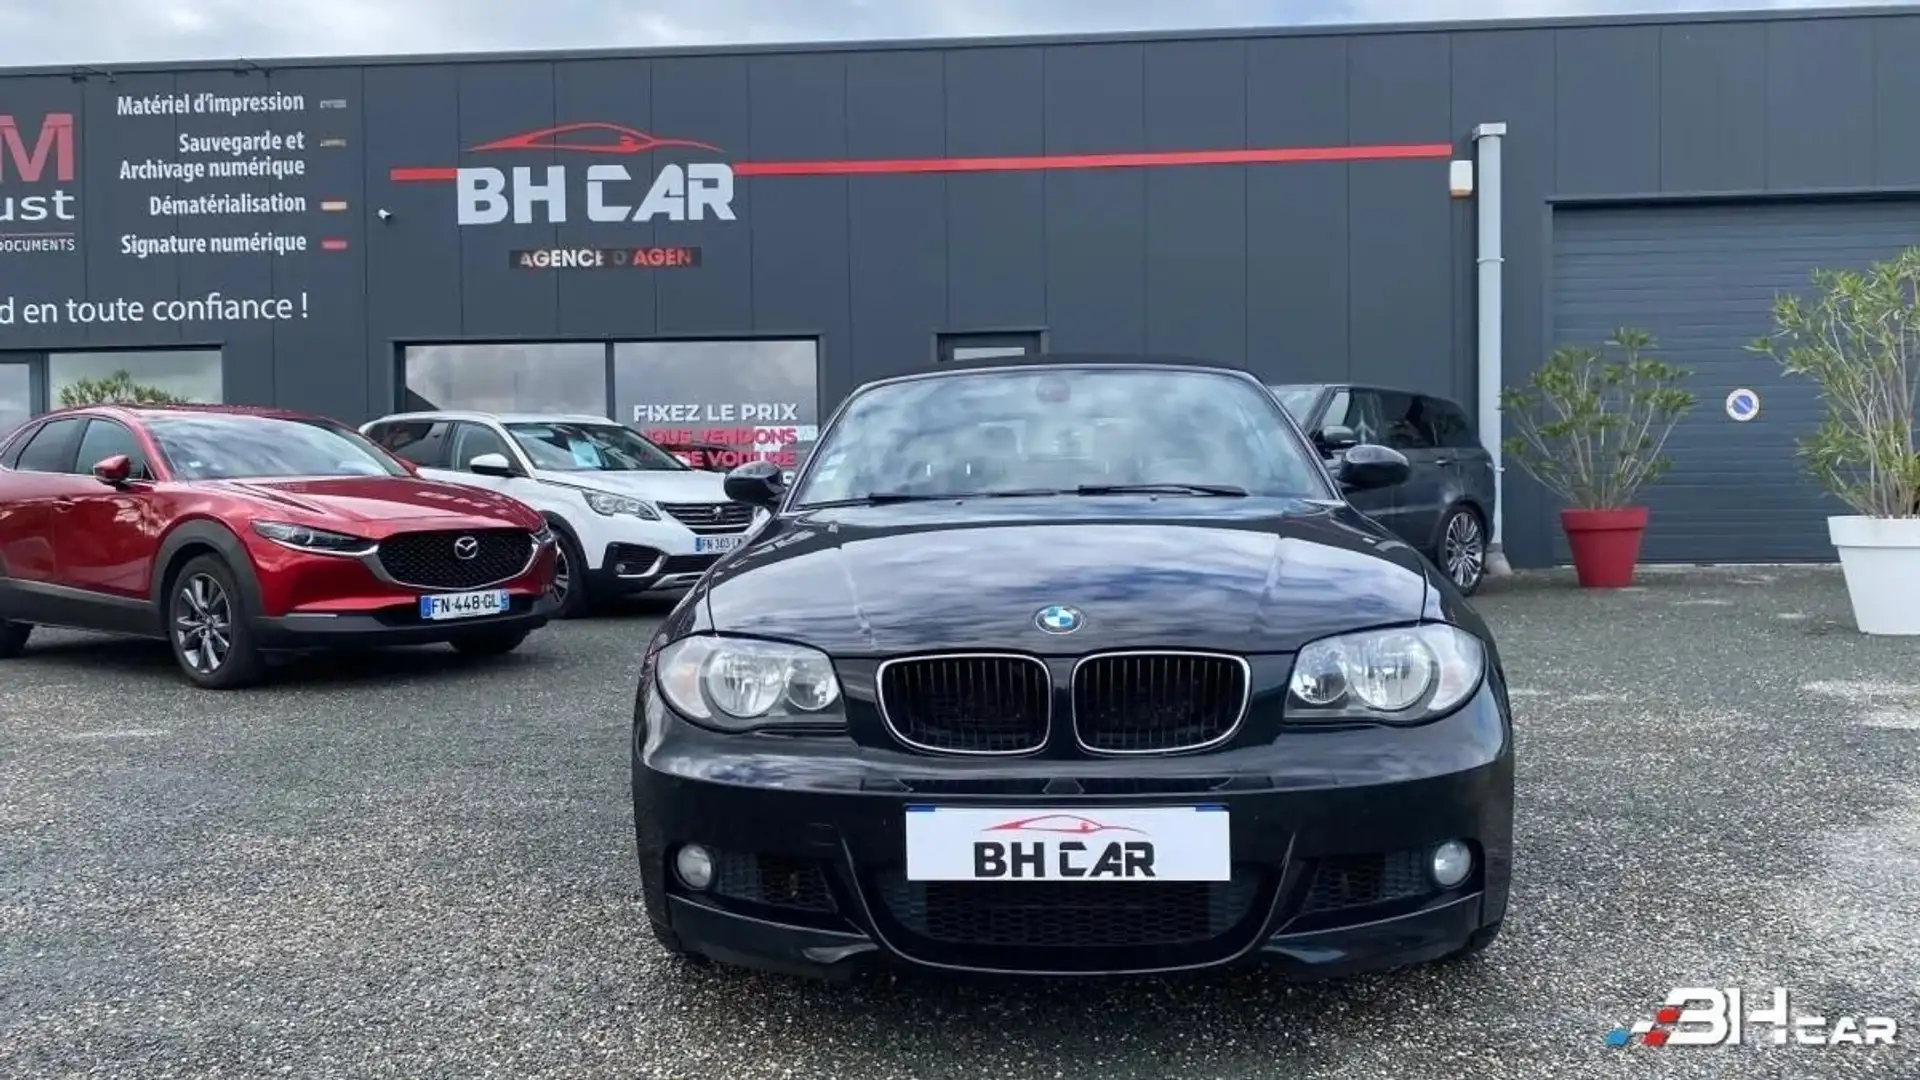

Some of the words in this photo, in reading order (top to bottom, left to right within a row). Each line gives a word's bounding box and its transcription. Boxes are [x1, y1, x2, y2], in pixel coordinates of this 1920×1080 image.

[117, 94, 190, 115] Matériel
[193, 92, 305, 116] d'impression
[179, 130, 282, 156] Sauvegarde
[286, 131, 305, 150] et
[119, 159, 204, 182] Archivage
[209, 156, 305, 180] numérique
[149, 193, 307, 215] Dématérialisation
[457, 164, 567, 226] BH
[587, 162, 737, 222] CAR
[121, 233, 207, 259] Signature
[210, 232, 307, 256] numérique
[23, 303, 58, 323] en
[66, 298, 144, 323] toute
[152, 292, 294, 322] confiance
[633, 404, 701, 422] FIXEZ
[707, 403, 735, 421] LE
[741, 403, 798, 421] PRIX
[702, 427, 797, 446] VENDONS
[974, 841, 1045, 878] BH
[1059, 841, 1156, 878] CAR
